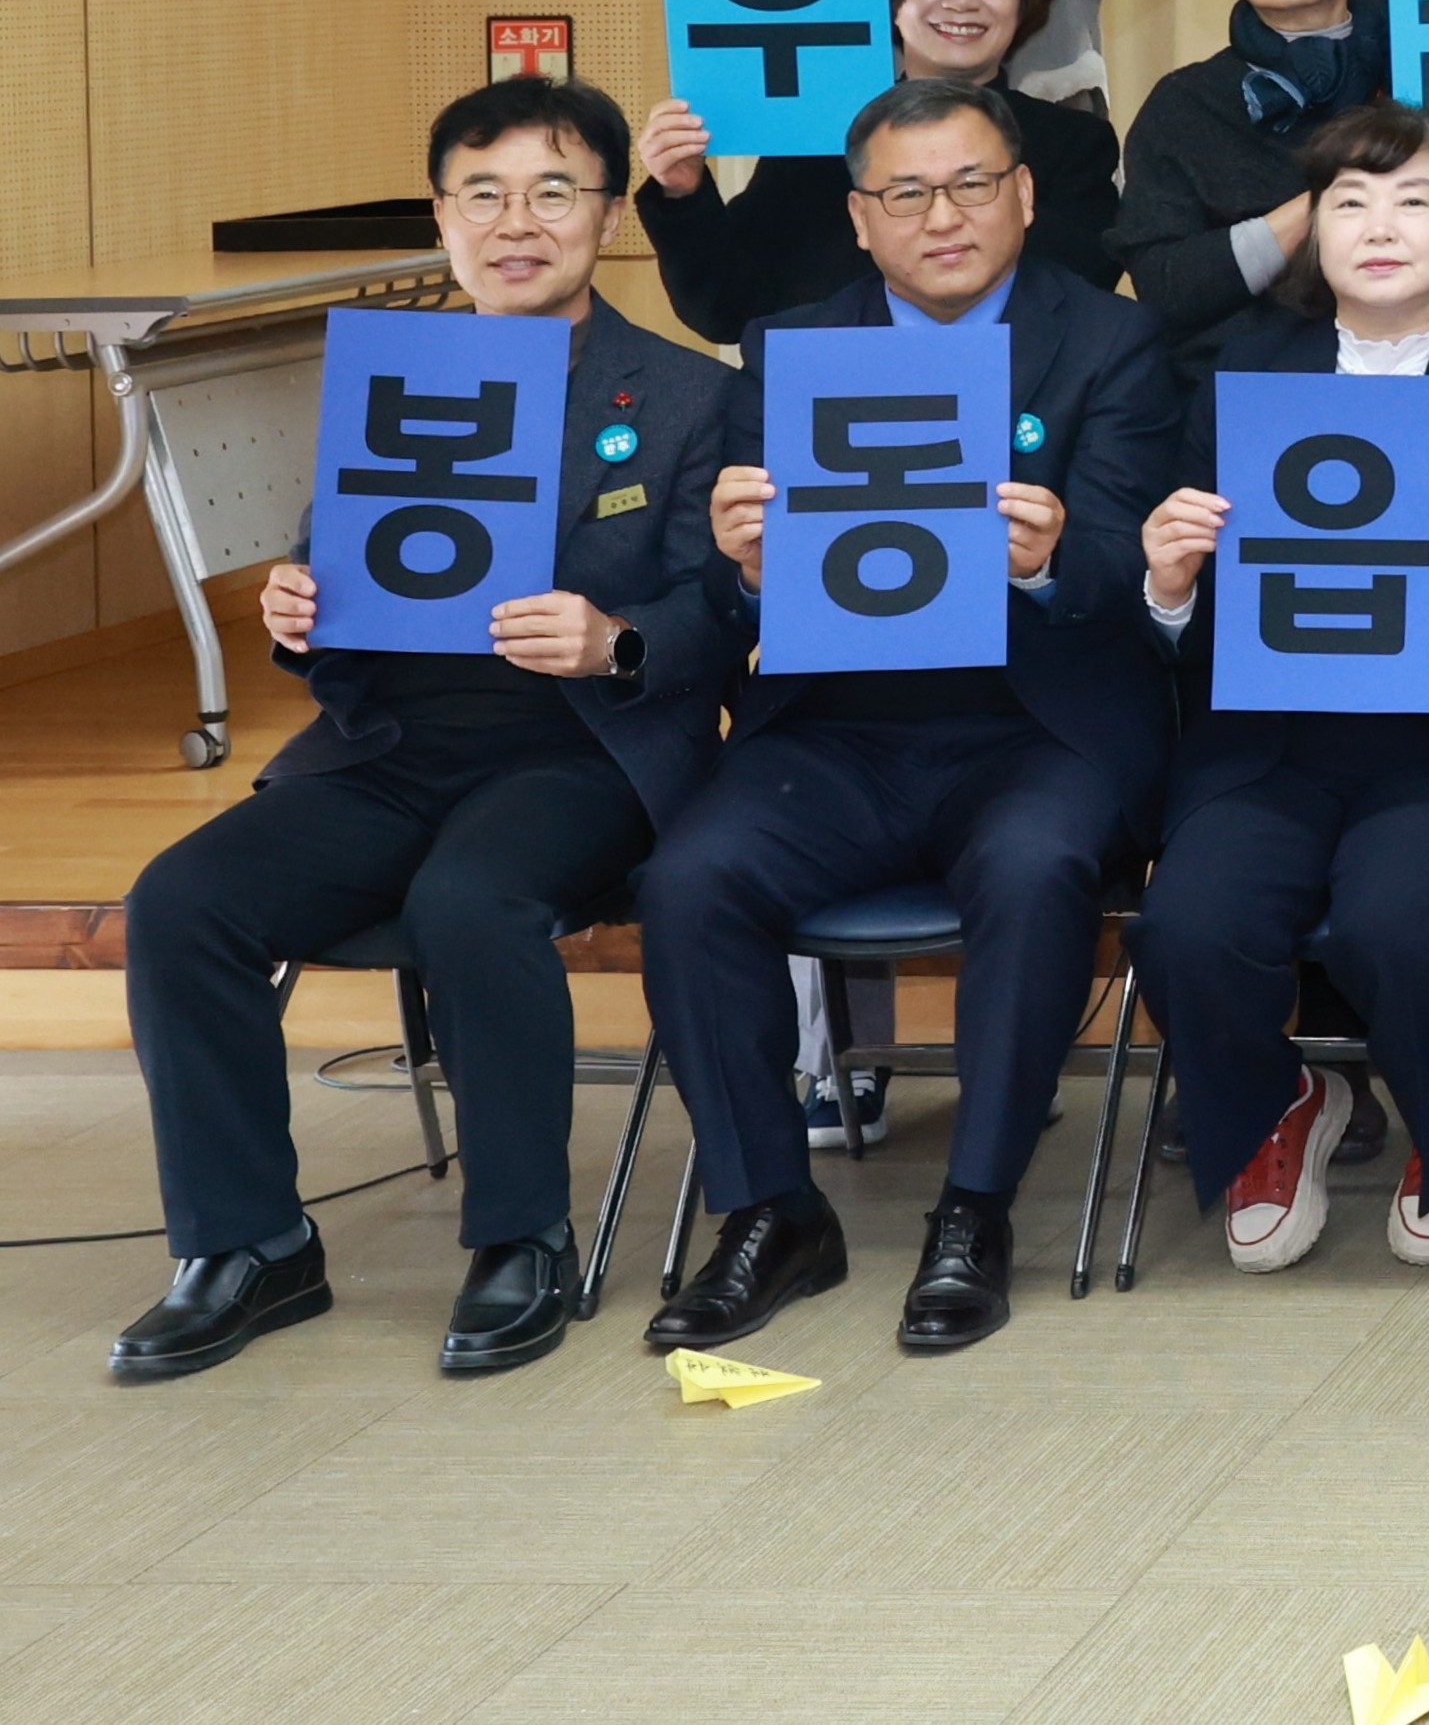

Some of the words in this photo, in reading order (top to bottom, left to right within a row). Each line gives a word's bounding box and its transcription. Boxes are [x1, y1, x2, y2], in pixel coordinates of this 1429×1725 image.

[498, 26, 560, 47] 소화기
[338, 376, 536, 599] 봉
[788, 395, 986, 616] 동
